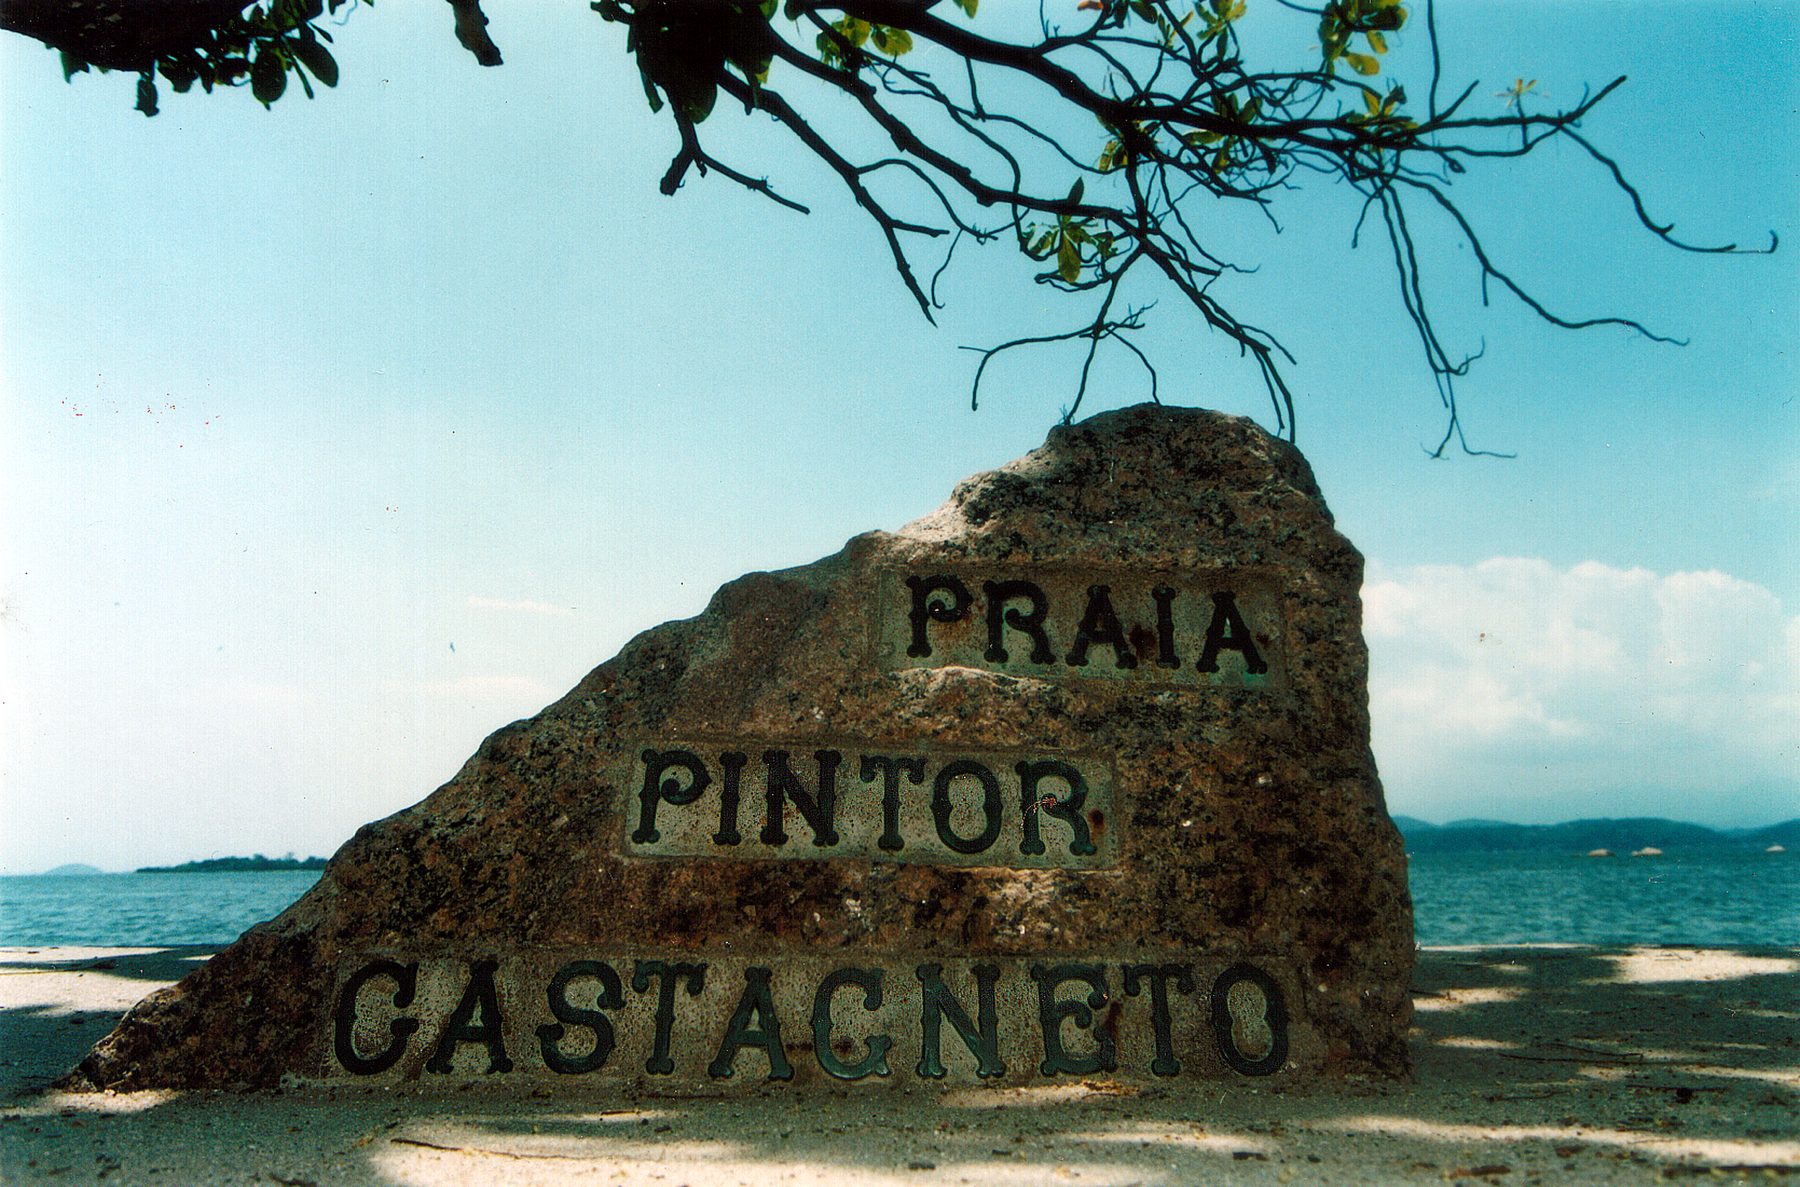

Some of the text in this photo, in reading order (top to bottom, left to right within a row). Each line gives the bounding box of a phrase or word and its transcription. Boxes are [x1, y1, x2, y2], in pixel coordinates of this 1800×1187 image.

[906, 574, 1268, 674] PRAIA
[631, 749, 1098, 855] PINTOR
[334, 960, 1289, 1081] CASTAGNETO
